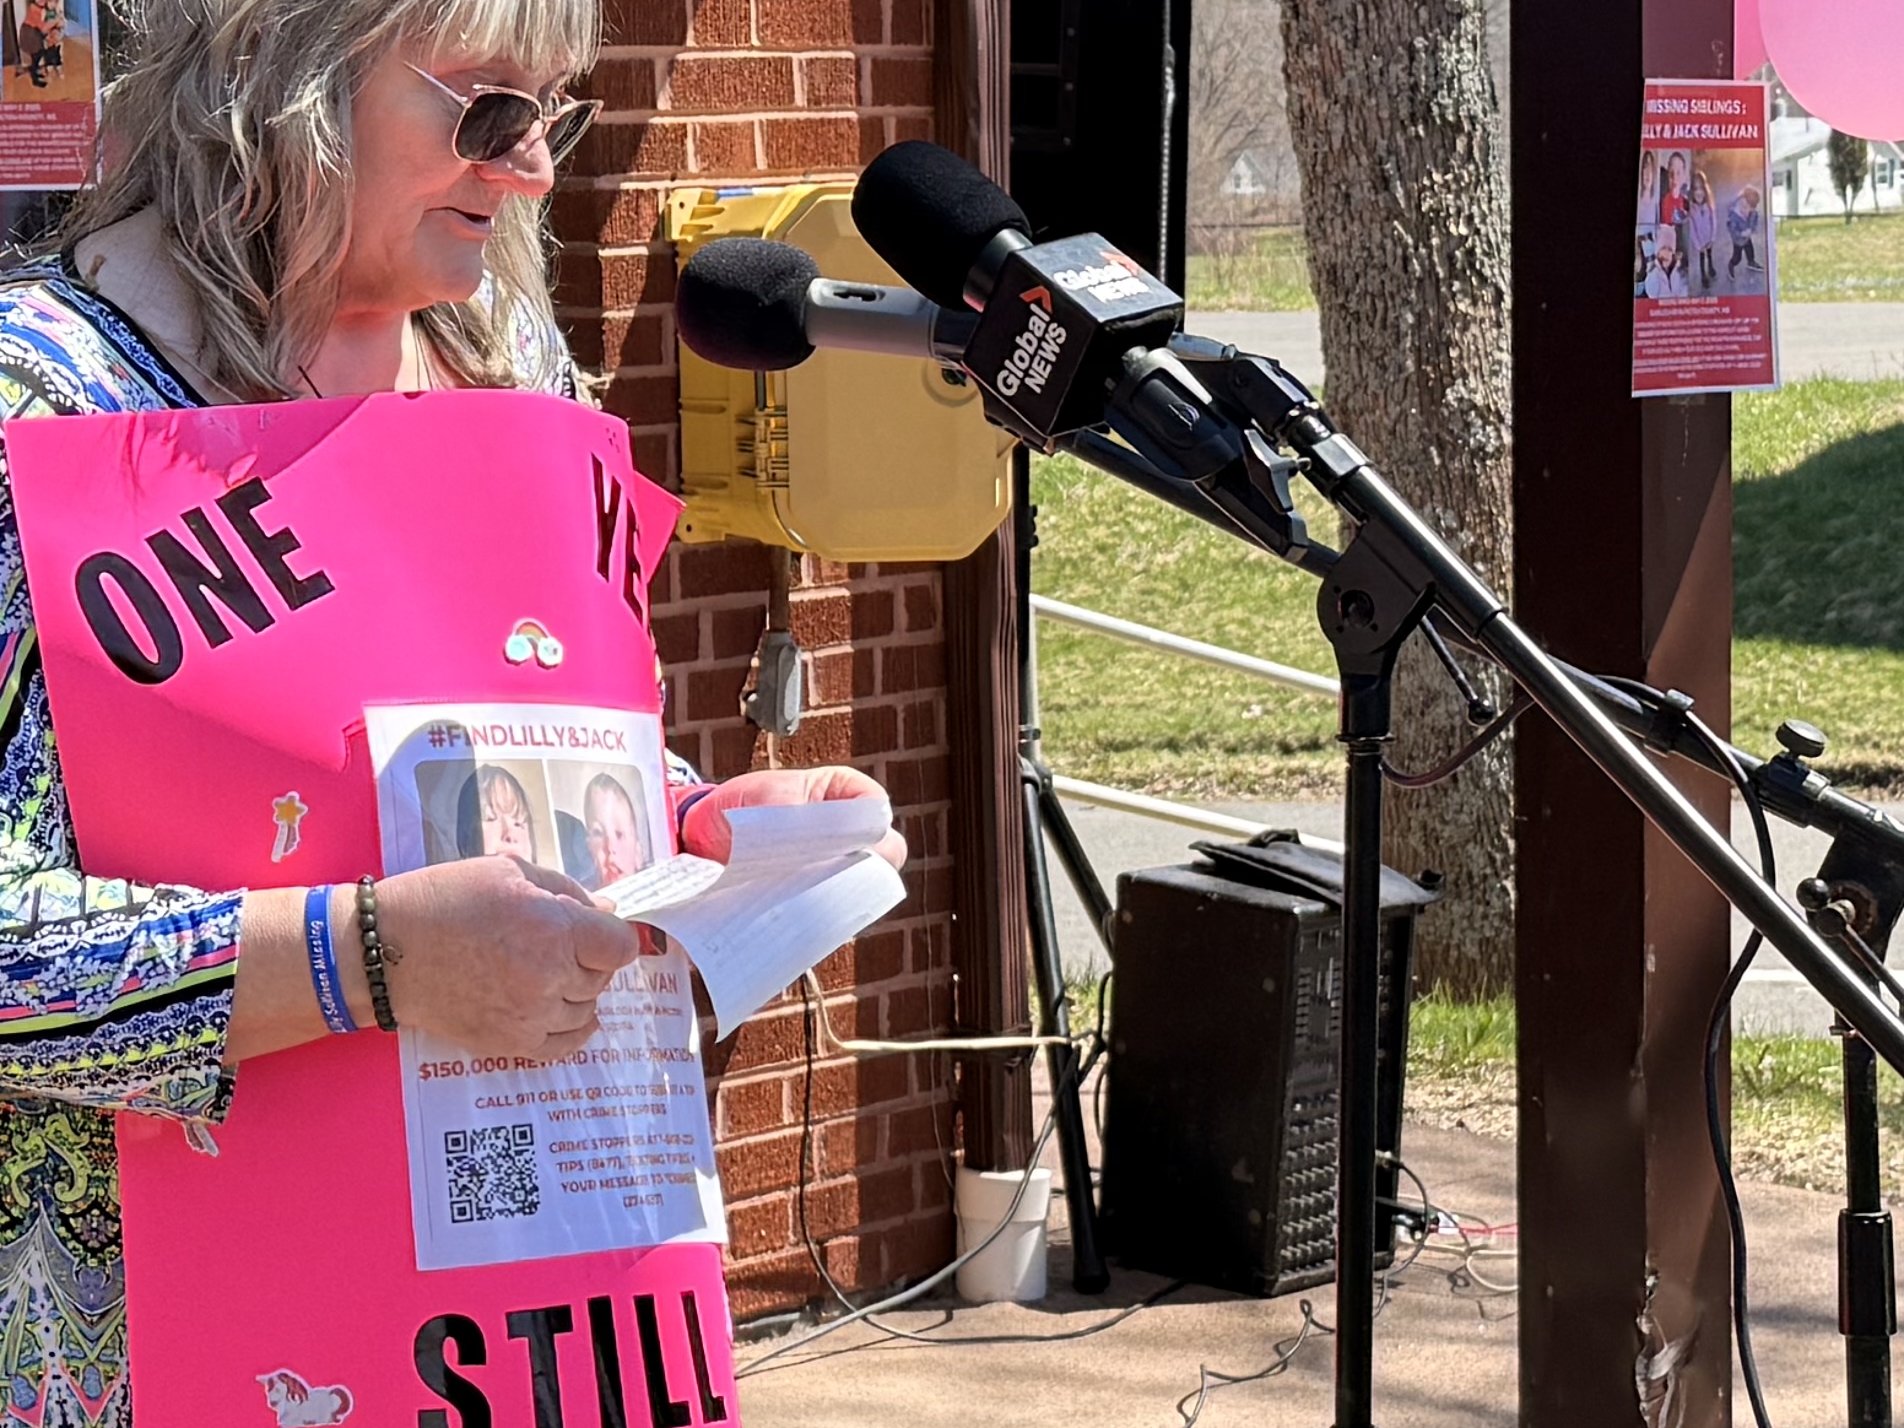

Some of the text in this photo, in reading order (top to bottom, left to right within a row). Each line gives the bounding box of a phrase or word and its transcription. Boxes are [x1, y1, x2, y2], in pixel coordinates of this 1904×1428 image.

[1700, 124, 1758, 139] SULLIVAN
[1053, 259, 1132, 290] Global
[1087, 276, 1152, 303] NEWS
[996, 303, 1051, 397] Global
[1024, 322, 1067, 394] NEWS
[75, 452, 644, 685] ONE YE
[427, 724, 627, 753] #FINDLILLY&JACK
[419, 1056, 508, 1082] $150,000
[591, 1048, 620, 1064] FOR
[475, 1095, 513, 1110] CALL
[516, 1091, 535, 1105] 911
[538, 1089, 558, 1103] OR
[561, 1088, 583, 1101] USE
[547, 1109, 582, 1123] WITH
[584, 1107, 618, 1120] CRIME
[549, 1139, 589, 1154] CRIME
[556, 1160, 585, 1173] TIPS
[560, 1180, 597, 1193] YOUR
